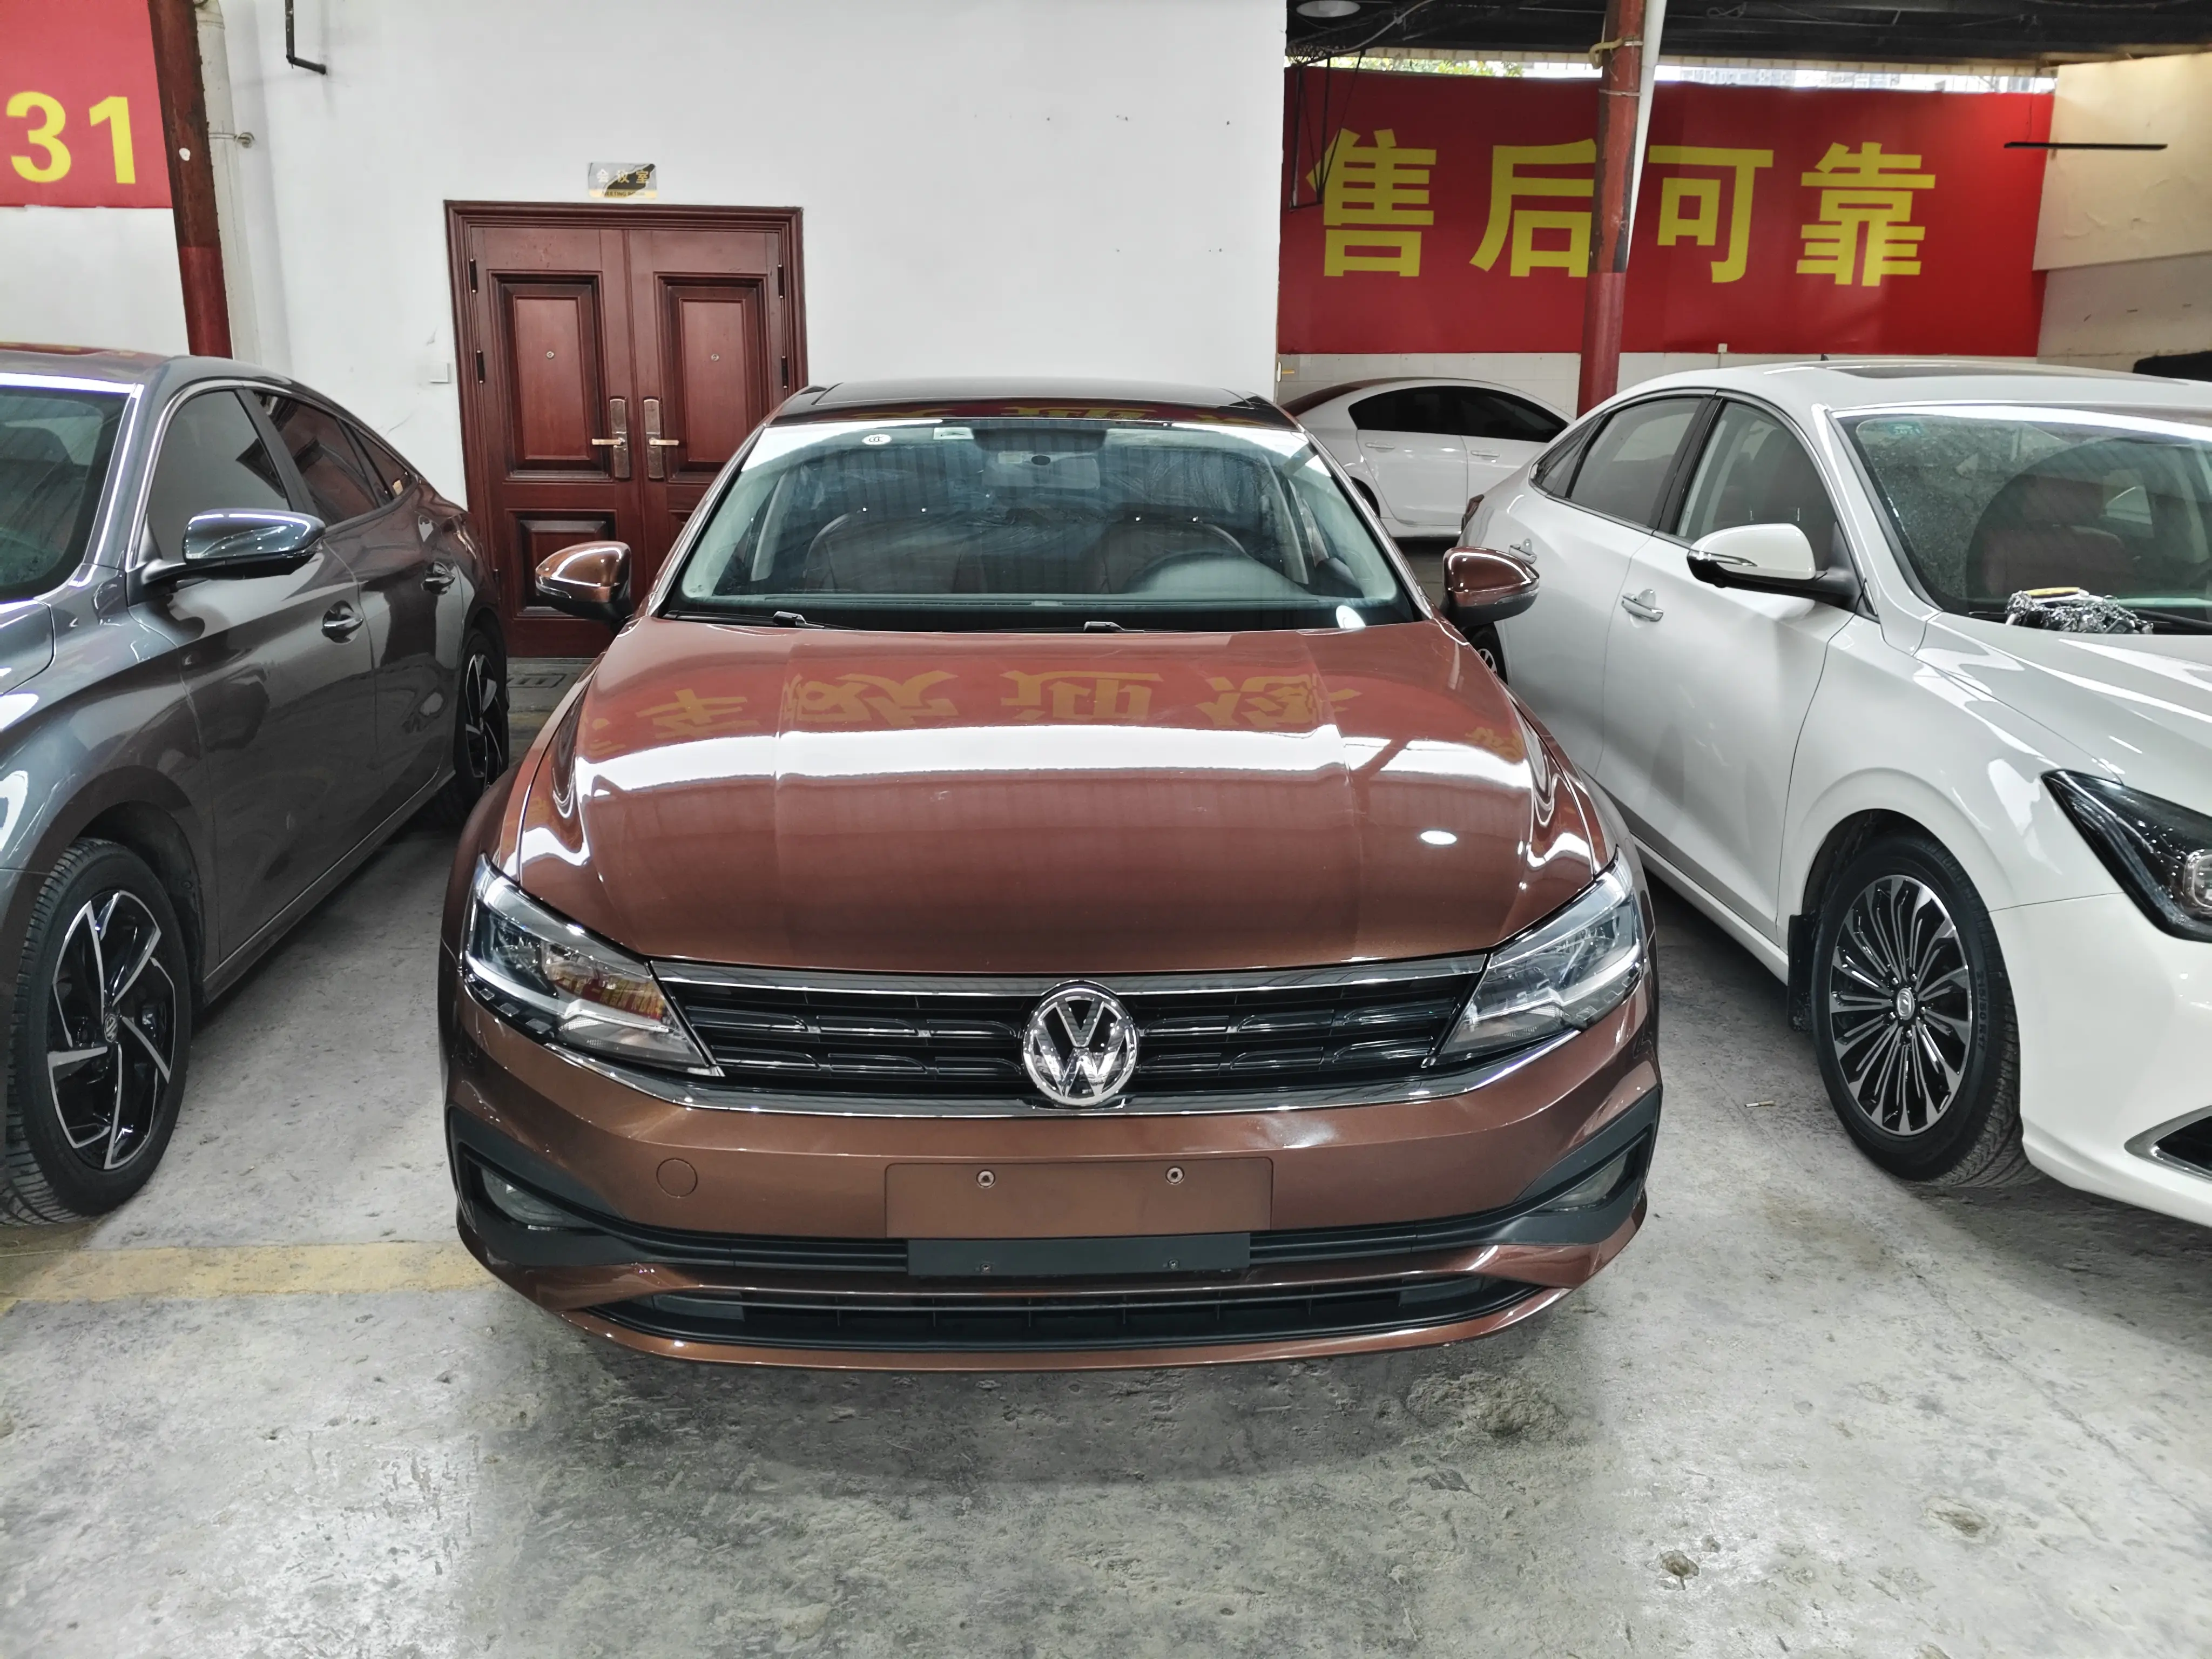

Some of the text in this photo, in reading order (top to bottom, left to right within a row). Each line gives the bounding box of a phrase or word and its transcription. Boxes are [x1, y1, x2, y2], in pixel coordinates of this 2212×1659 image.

[6, 91, 136, 184] 31
[1306, 127, 1936, 287] 售后可靠
